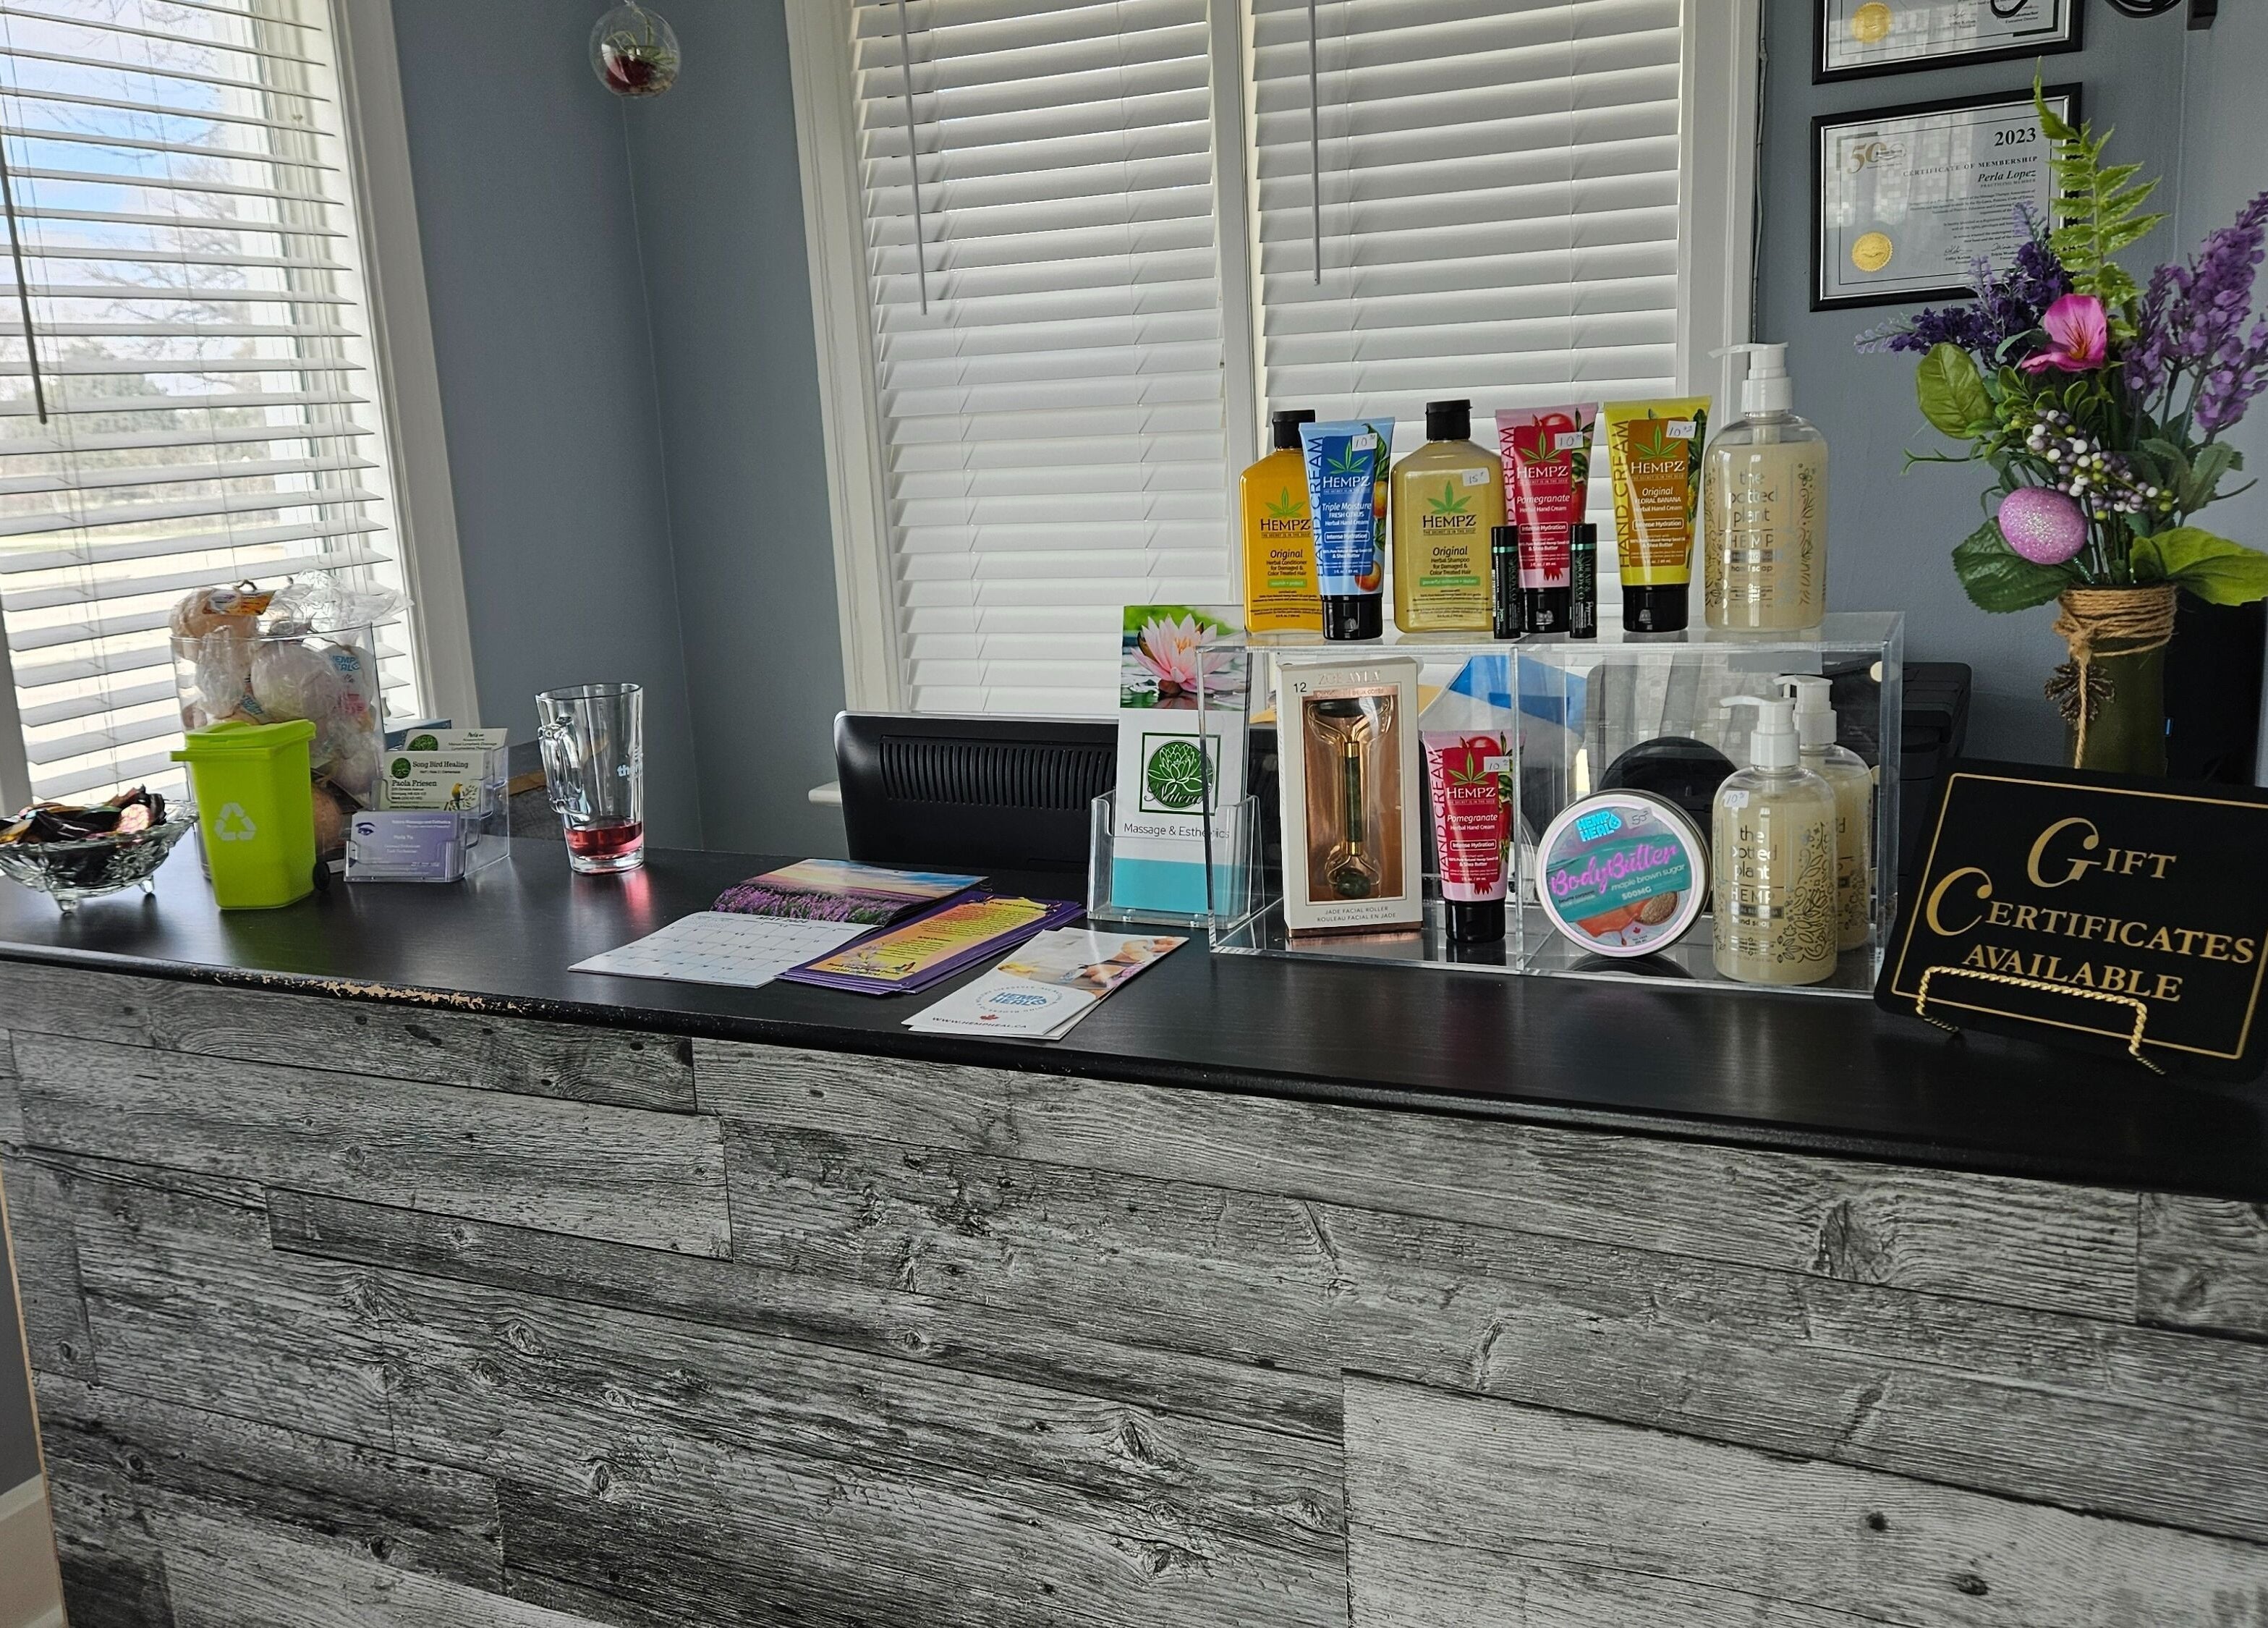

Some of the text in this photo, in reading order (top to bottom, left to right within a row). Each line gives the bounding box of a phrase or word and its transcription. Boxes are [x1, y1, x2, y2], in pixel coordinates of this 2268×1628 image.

[1994, 127, 2036, 146] 2023
[1903, 165, 1959, 177] CERTIFICATE
[1979, 156, 2037, 169] MEMBERSHIP
[1978, 169, 2036, 182] Perla Lopez
[1499, 427, 1516, 501] CREAM
[1631, 460, 1685, 474] HEMPZ
[1516, 465, 1568, 479] HEMPZ
[1739, 469, 1764, 485] the
[1322, 475, 1371, 488] HEMPZ
[1516, 493, 1571, 505] Pomegranate
[1612, 420, 1631, 569] HAND CREAM
[1641, 486, 1673, 499] Original
[1308, 436, 1324, 577] HAND CREAM
[1322, 503, 1341, 512] Triple
[1260, 519, 1311, 531] HEMPZ
[1422, 514, 1477, 528] HEMPZ
[1270, 548, 1303, 560] Original
[1432, 546, 1468, 558] Original
[1294, 682, 1307, 693] 12
[1446, 787, 1496, 800] HEMPZ
[1428, 748, 1451, 883] HAND CREAM
[1446, 814, 1498, 824] Pomegranate
[1576, 810, 1610, 831] HEMP
[1124, 823, 1230, 839] Massage & Esthics
[1579, 824, 1615, 842] HEAL
[1739, 825, 1765, 843] the
[2026, 817, 2177, 889] GIFT
[1611, 863, 1686, 891] maple brown sugar
[1621, 886, 1652, 901] 500MG
[1925, 866, 2256, 964] CERTIFICATES
[1961, 944, 2184, 1002] AVAILABLE
[988, 996, 1031, 1006] HEAL
[996, 992, 1045, 1001] HEMP
